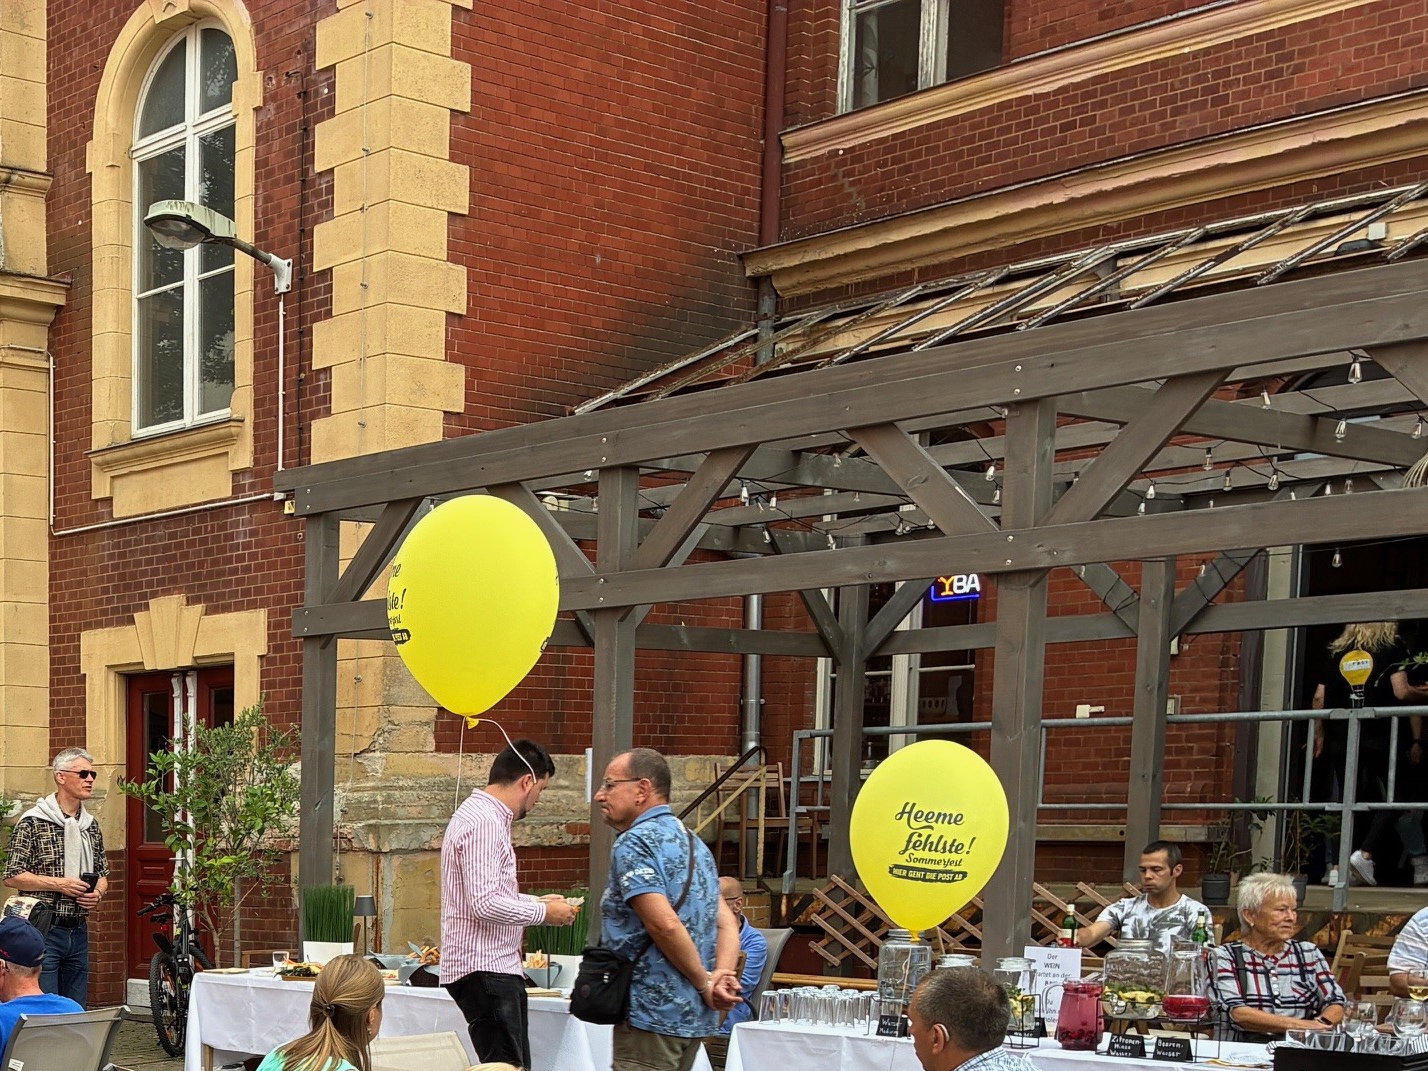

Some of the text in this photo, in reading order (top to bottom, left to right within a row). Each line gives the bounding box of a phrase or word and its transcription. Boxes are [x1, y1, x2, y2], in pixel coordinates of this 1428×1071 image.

[894, 801, 966, 831] Heeme
[898, 831, 977, 855] fehlste!
[905, 852, 964, 869] Sommerfest
[907, 870, 926, 879] GEHT
[926, 872, 937, 880] DIE
[937, 873, 954, 881] POST
[953, 873, 964, 881] AB
[1043, 962, 1061, 970] WEIN
